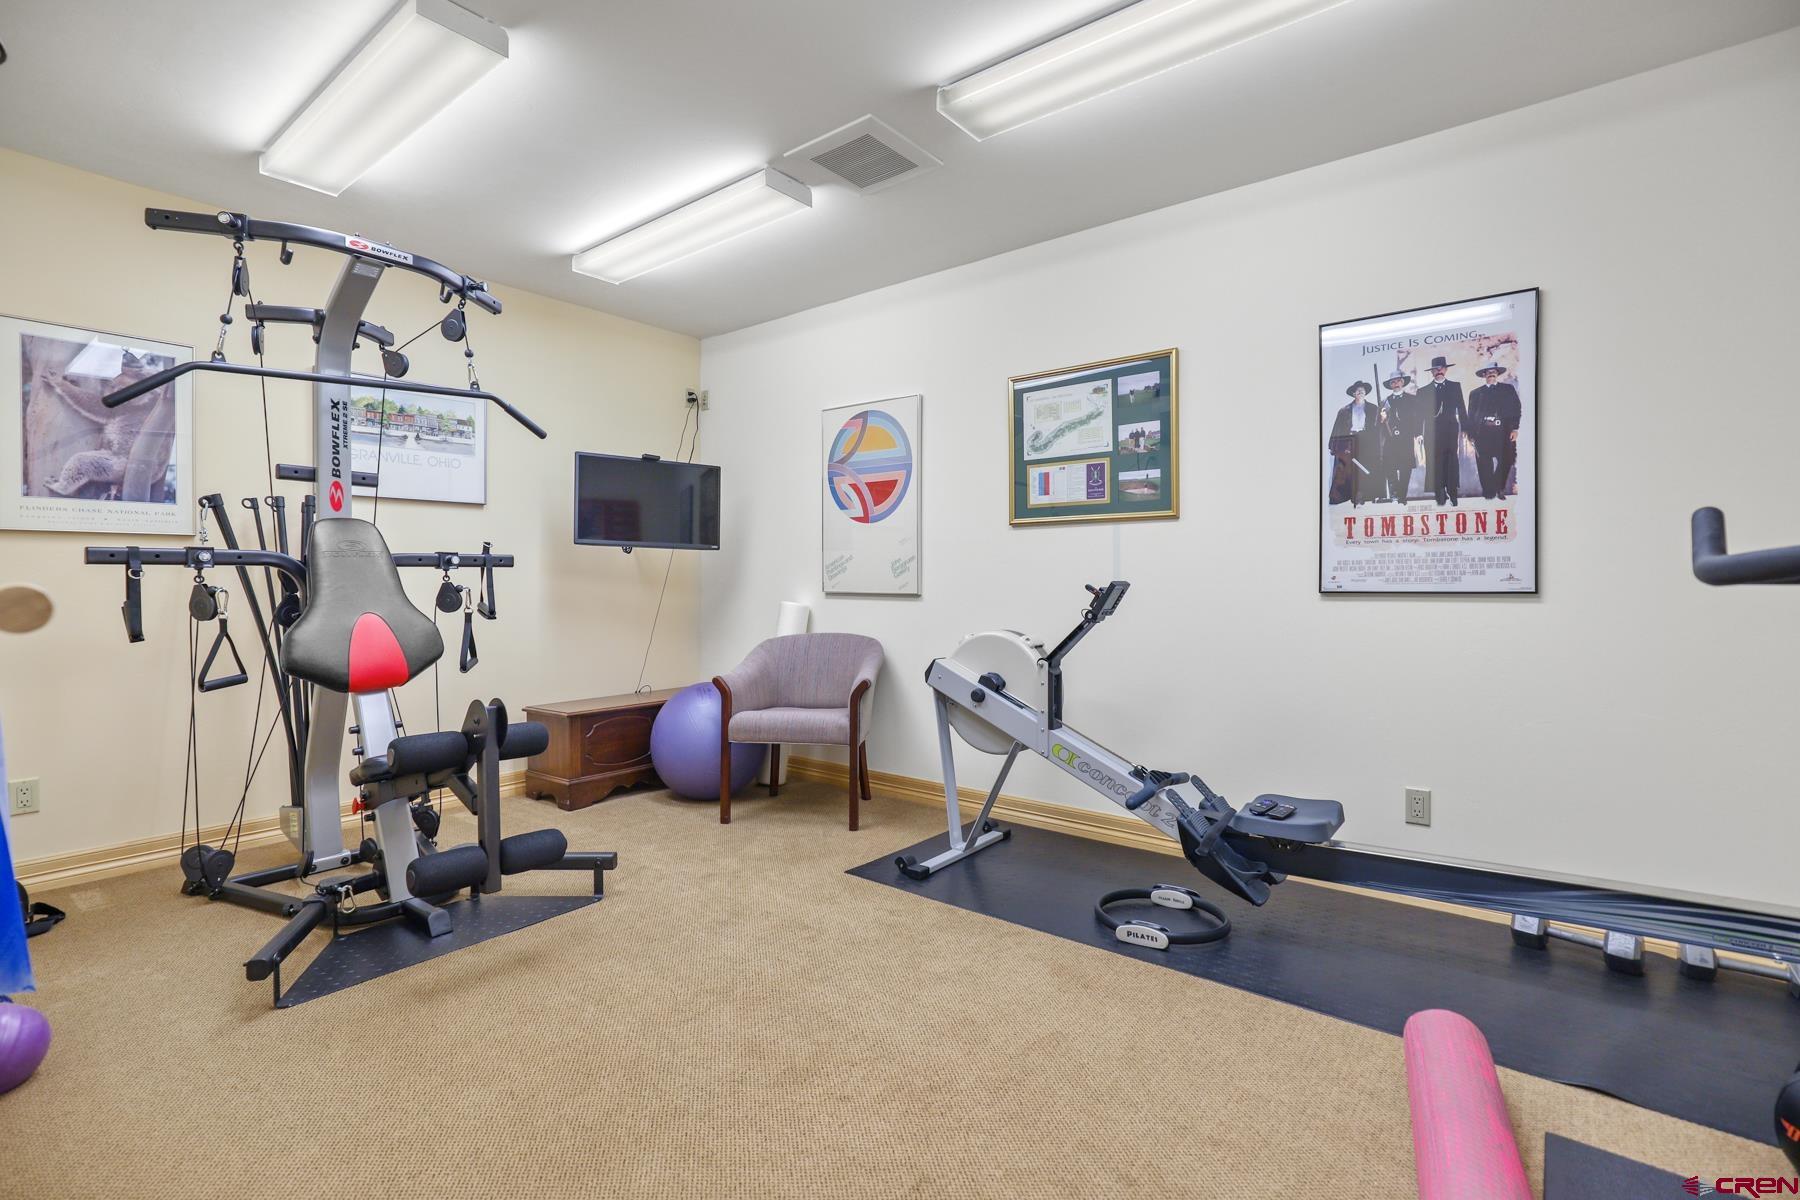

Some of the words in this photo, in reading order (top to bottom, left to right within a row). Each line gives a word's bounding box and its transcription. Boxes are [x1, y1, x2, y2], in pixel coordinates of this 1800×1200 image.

[371, 246, 409, 261] BOWFLEX
[342, 400, 348, 411] SE
[330, 398, 341, 479] BOWFLEX
[427, 455, 462, 470] OHIO
[1344, 509, 1508, 540] TOMBSTONE
